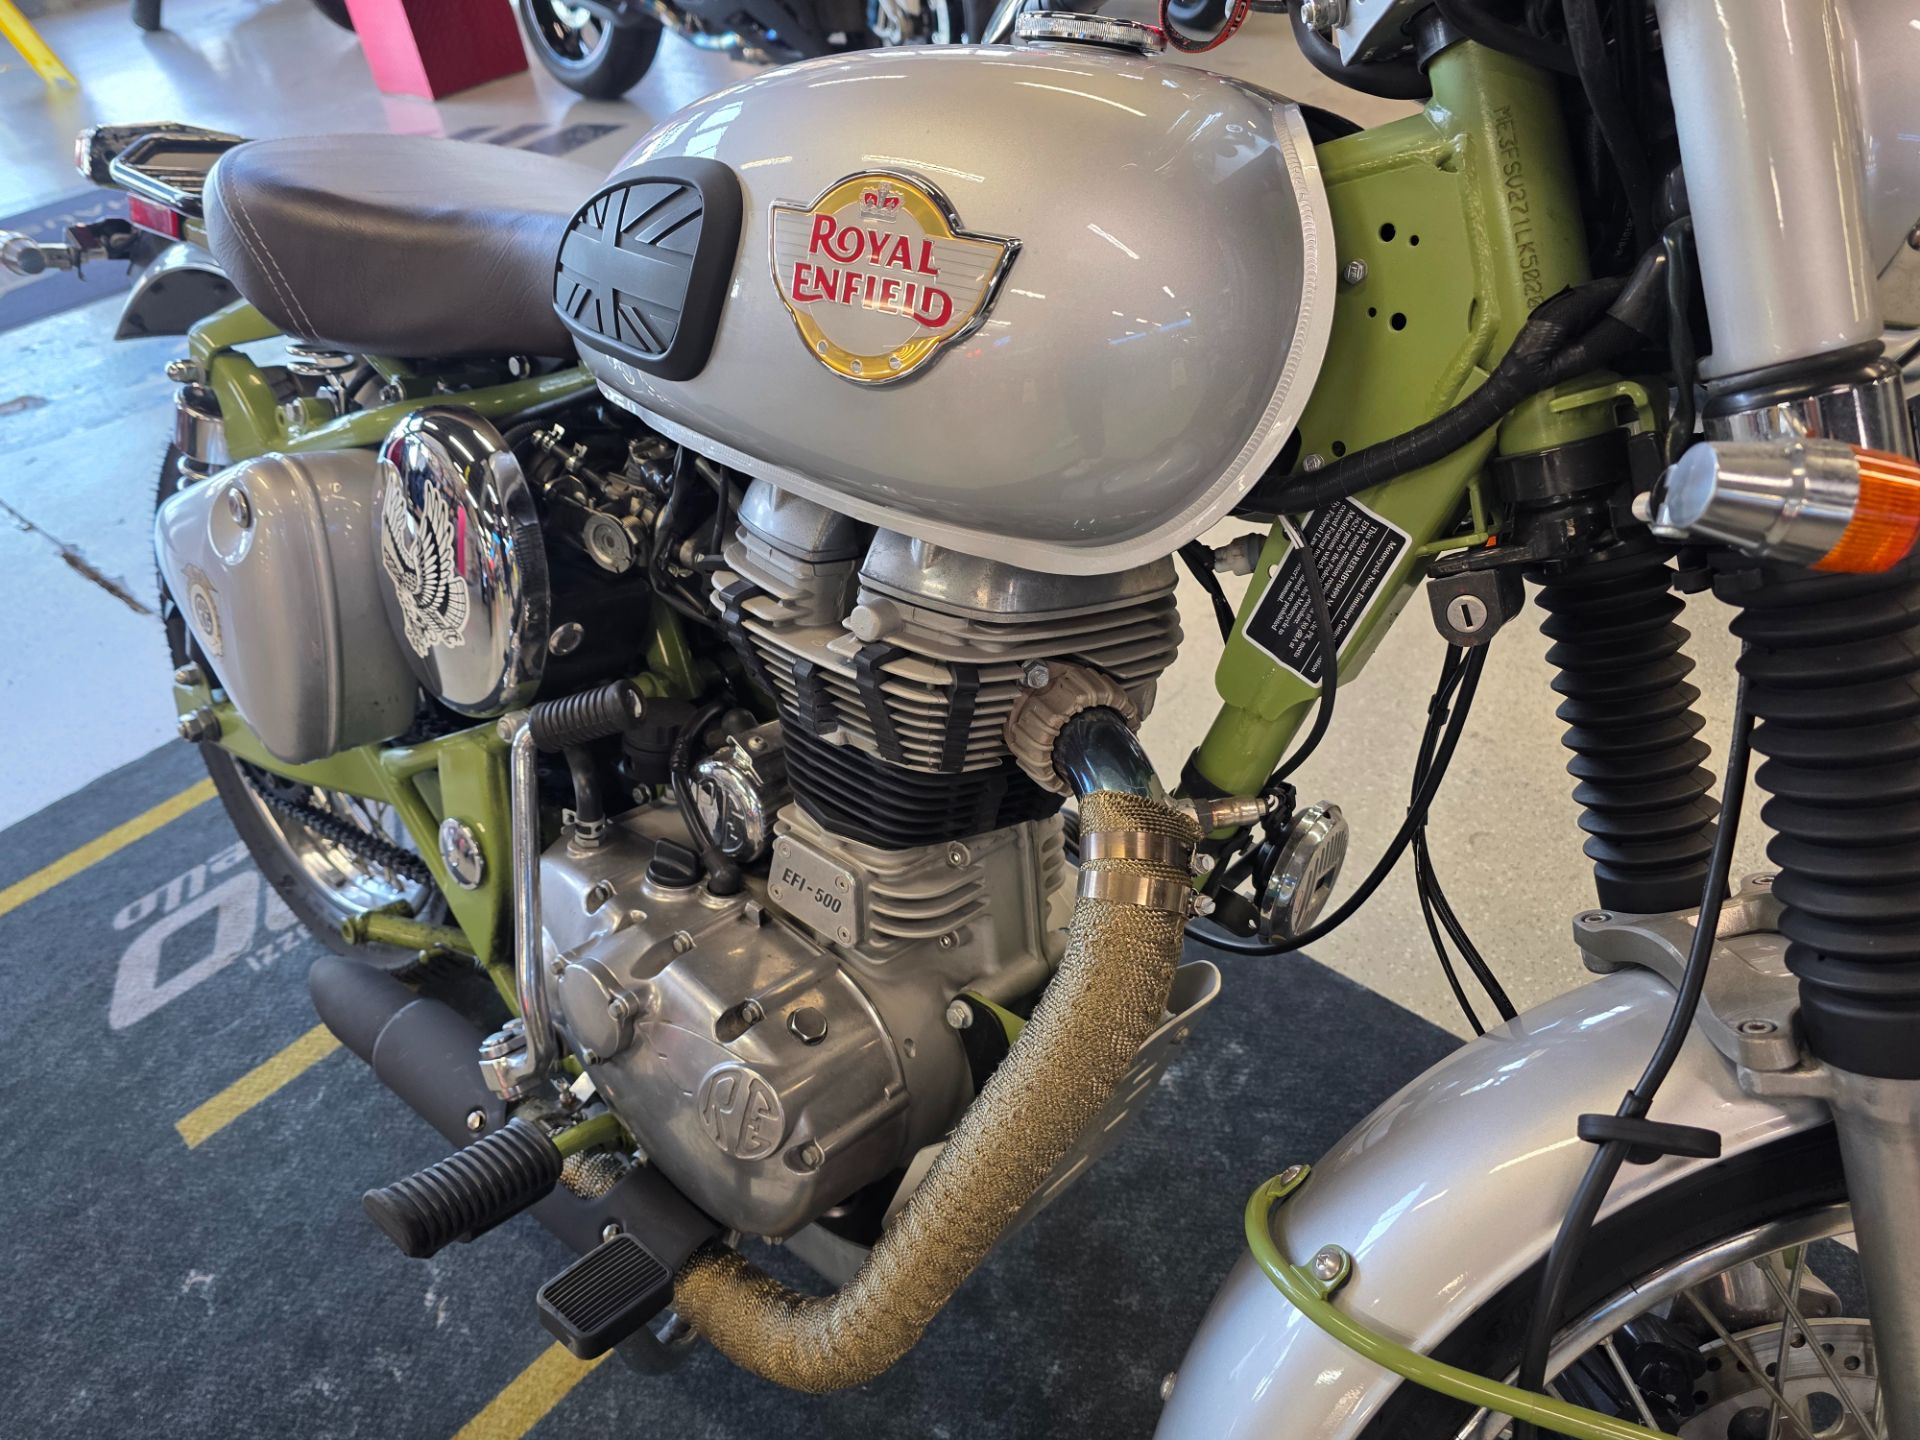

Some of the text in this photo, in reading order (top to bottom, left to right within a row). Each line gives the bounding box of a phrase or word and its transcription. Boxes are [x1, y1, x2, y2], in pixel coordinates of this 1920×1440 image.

[808, 213, 941, 276] ROYAL
[791, 262, 954, 329] ENFIELD
[1316, 509, 1335, 533] Federal
[1331, 503, 1347, 526] exceed
[1348, 514, 1362, 531] 3625
[1317, 526, 1335, 549] Federal
[1327, 509, 1355, 551] Modifications
[1339, 529, 1352, 544] rpm
[1364, 523, 1378, 540] This
[1330, 519, 1369, 577] EPA noise emission
[1354, 538, 1369, 556] 2020
[1370, 540, 1396, 576] Motorcycle
[1315, 550, 1331, 569] which
[1359, 574, 1375, 593] Noise
[1269, 600, 1291, 631] prohibited
[1280, 596, 1304, 629] Motorcycle
[1342, 591, 1364, 620] Emission
